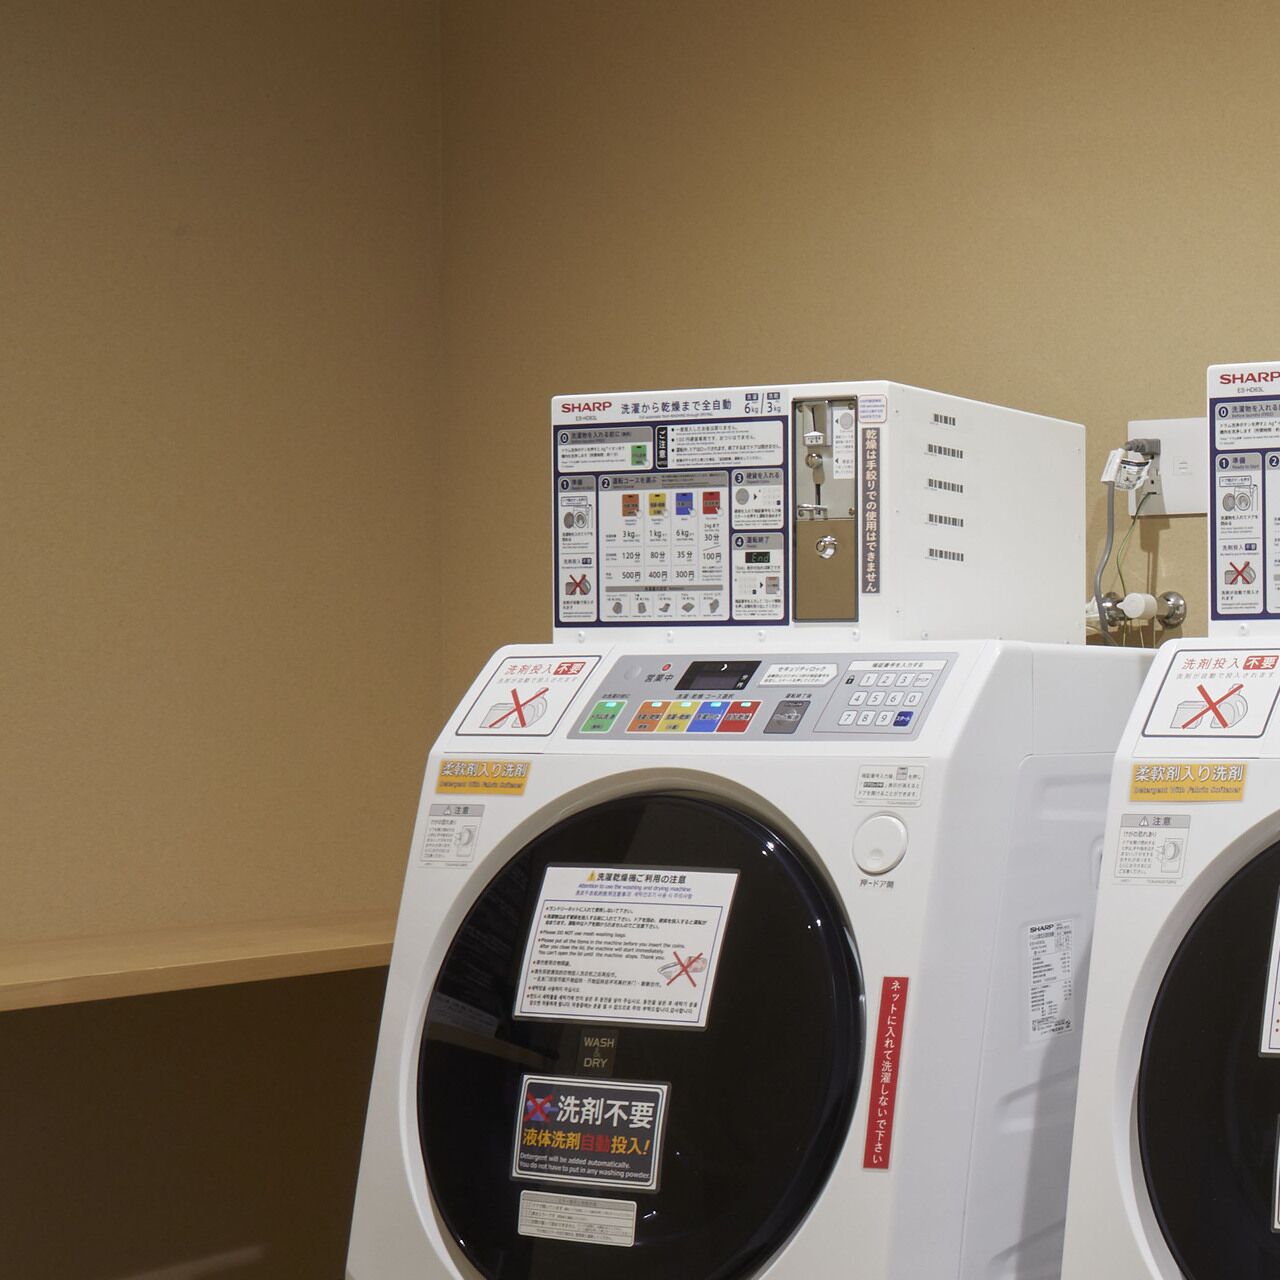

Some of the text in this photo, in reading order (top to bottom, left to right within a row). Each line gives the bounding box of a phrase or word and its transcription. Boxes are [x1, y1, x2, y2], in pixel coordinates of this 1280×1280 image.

[1220, 372, 1280, 384] SHARP
[561, 402, 612, 413] SHARP
[621, 399, 731, 414] 洗濯から乾燥まで全自動
[865, 429, 876, 592] 乾燥は手絞りでの使用はできません
[504, 662, 584, 675] 洗剤投入 不要
[1182, 656, 1278, 670] 洗剤投入 不要
[645, 674, 674, 683] 営業中
[441, 763, 528, 777] 柔軟剤入り洗剤
[1135, 765, 1243, 782] 柔軟剤入り洗剤
[1152, 817, 1171, 826] 注意
[597, 873, 686, 884] 洗濯乾燥機ご利用の注意
[584, 1037, 614, 1047] WASH
[584, 1058, 608, 1067] DRY
[872, 981, 901, 1164] ネットに入れて洗濯しないで下さい
[557, 1095, 655, 1128] 洗剤不要
